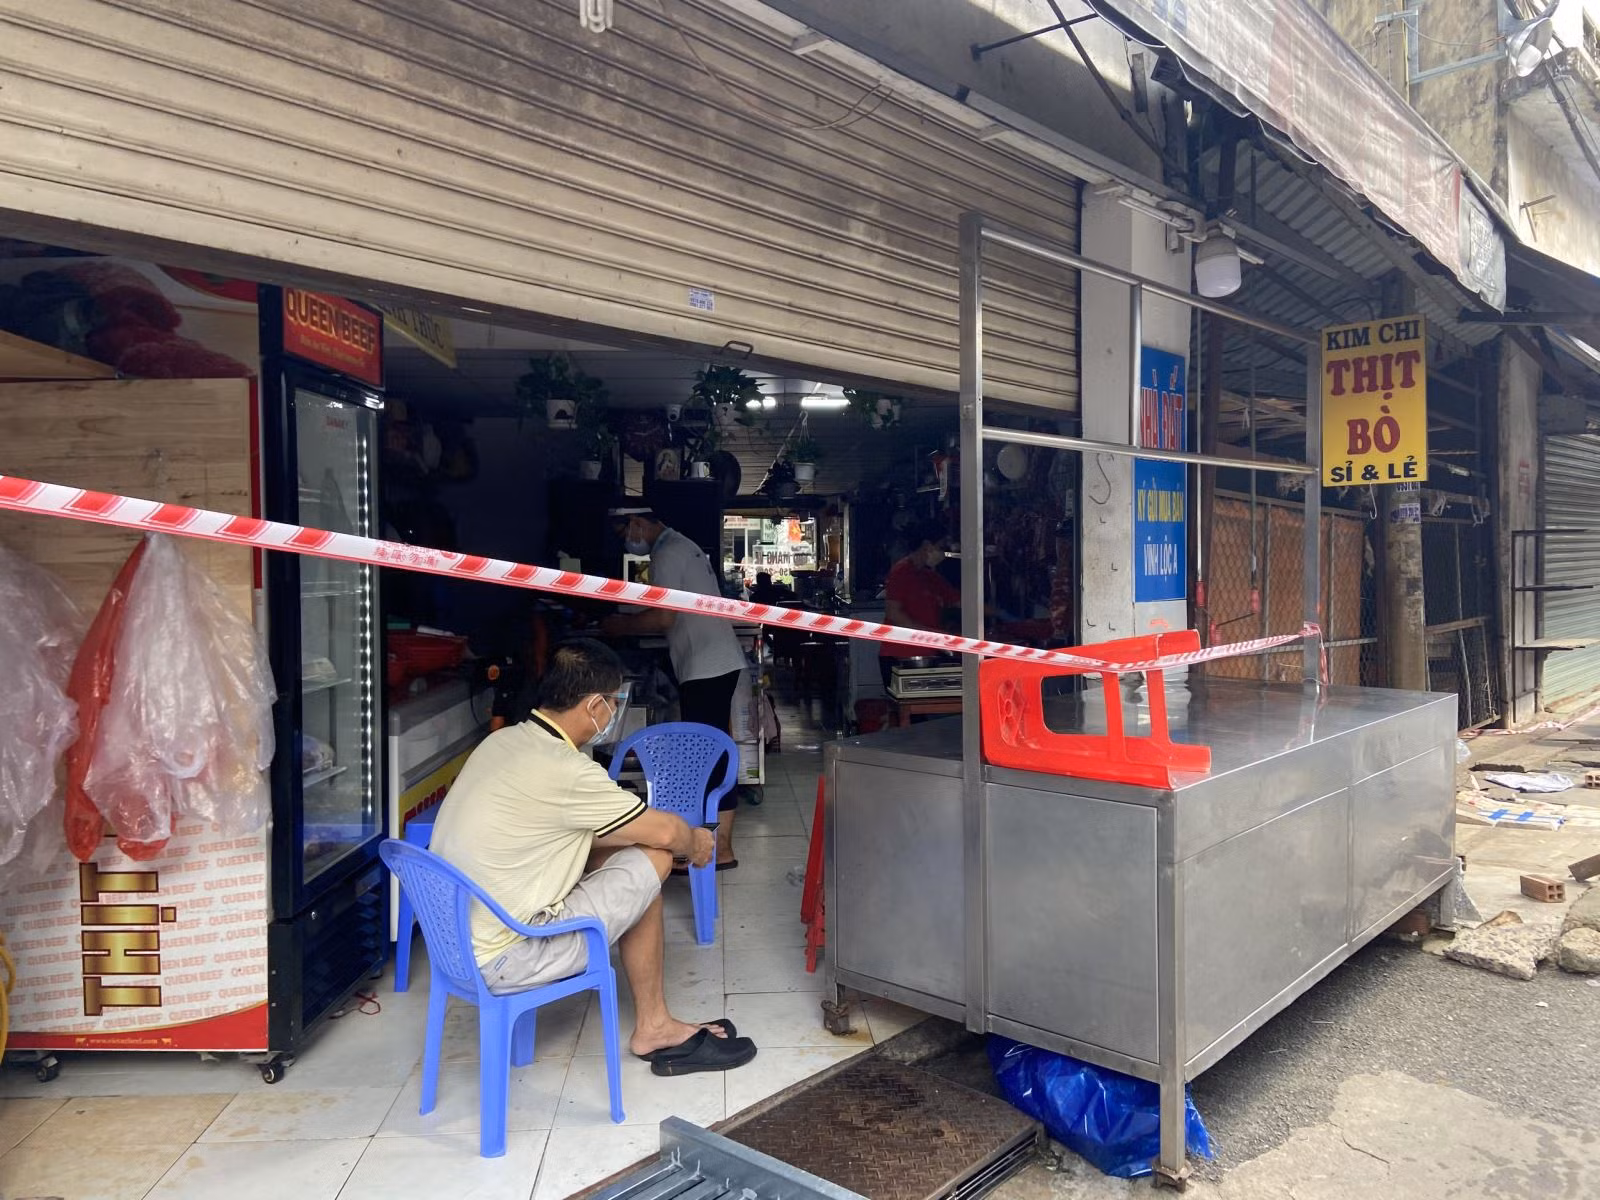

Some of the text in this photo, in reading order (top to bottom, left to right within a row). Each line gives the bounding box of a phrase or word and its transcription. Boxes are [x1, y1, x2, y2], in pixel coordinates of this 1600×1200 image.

[287, 288, 338, 340] QUEEN
[341, 310, 375, 354] BEEF
[1326, 320, 1421, 351] KIM CHI
[1326, 350, 1421, 400] THỊT
[1346, 405, 1401, 455] BÒ
[1330, 455, 1418, 482] SỈ & LẺ
[1143, 535, 1178, 582] VĨNH LỘC A
[198, 837, 260, 854] QUEEN BEEF
[216, 855, 250, 867] QUEEN
[203, 879, 238, 891] QUEEN
[222, 892, 256, 904] QUEEN
[209, 914, 242, 926] QUEEN
[79, 862, 176, 1016] THỊT
[226, 927, 260, 939] QUEEN
[214, 950, 248, 963] QUEEN
[249, 947, 267, 958] BEE
[165, 973, 198, 986] QUEEN
[198, 969, 223, 982] BEEF
[231, 964, 265, 977] QUEEN
[218, 986, 253, 999] QUEEN
[169, 1008, 202, 1021] QUEEN
